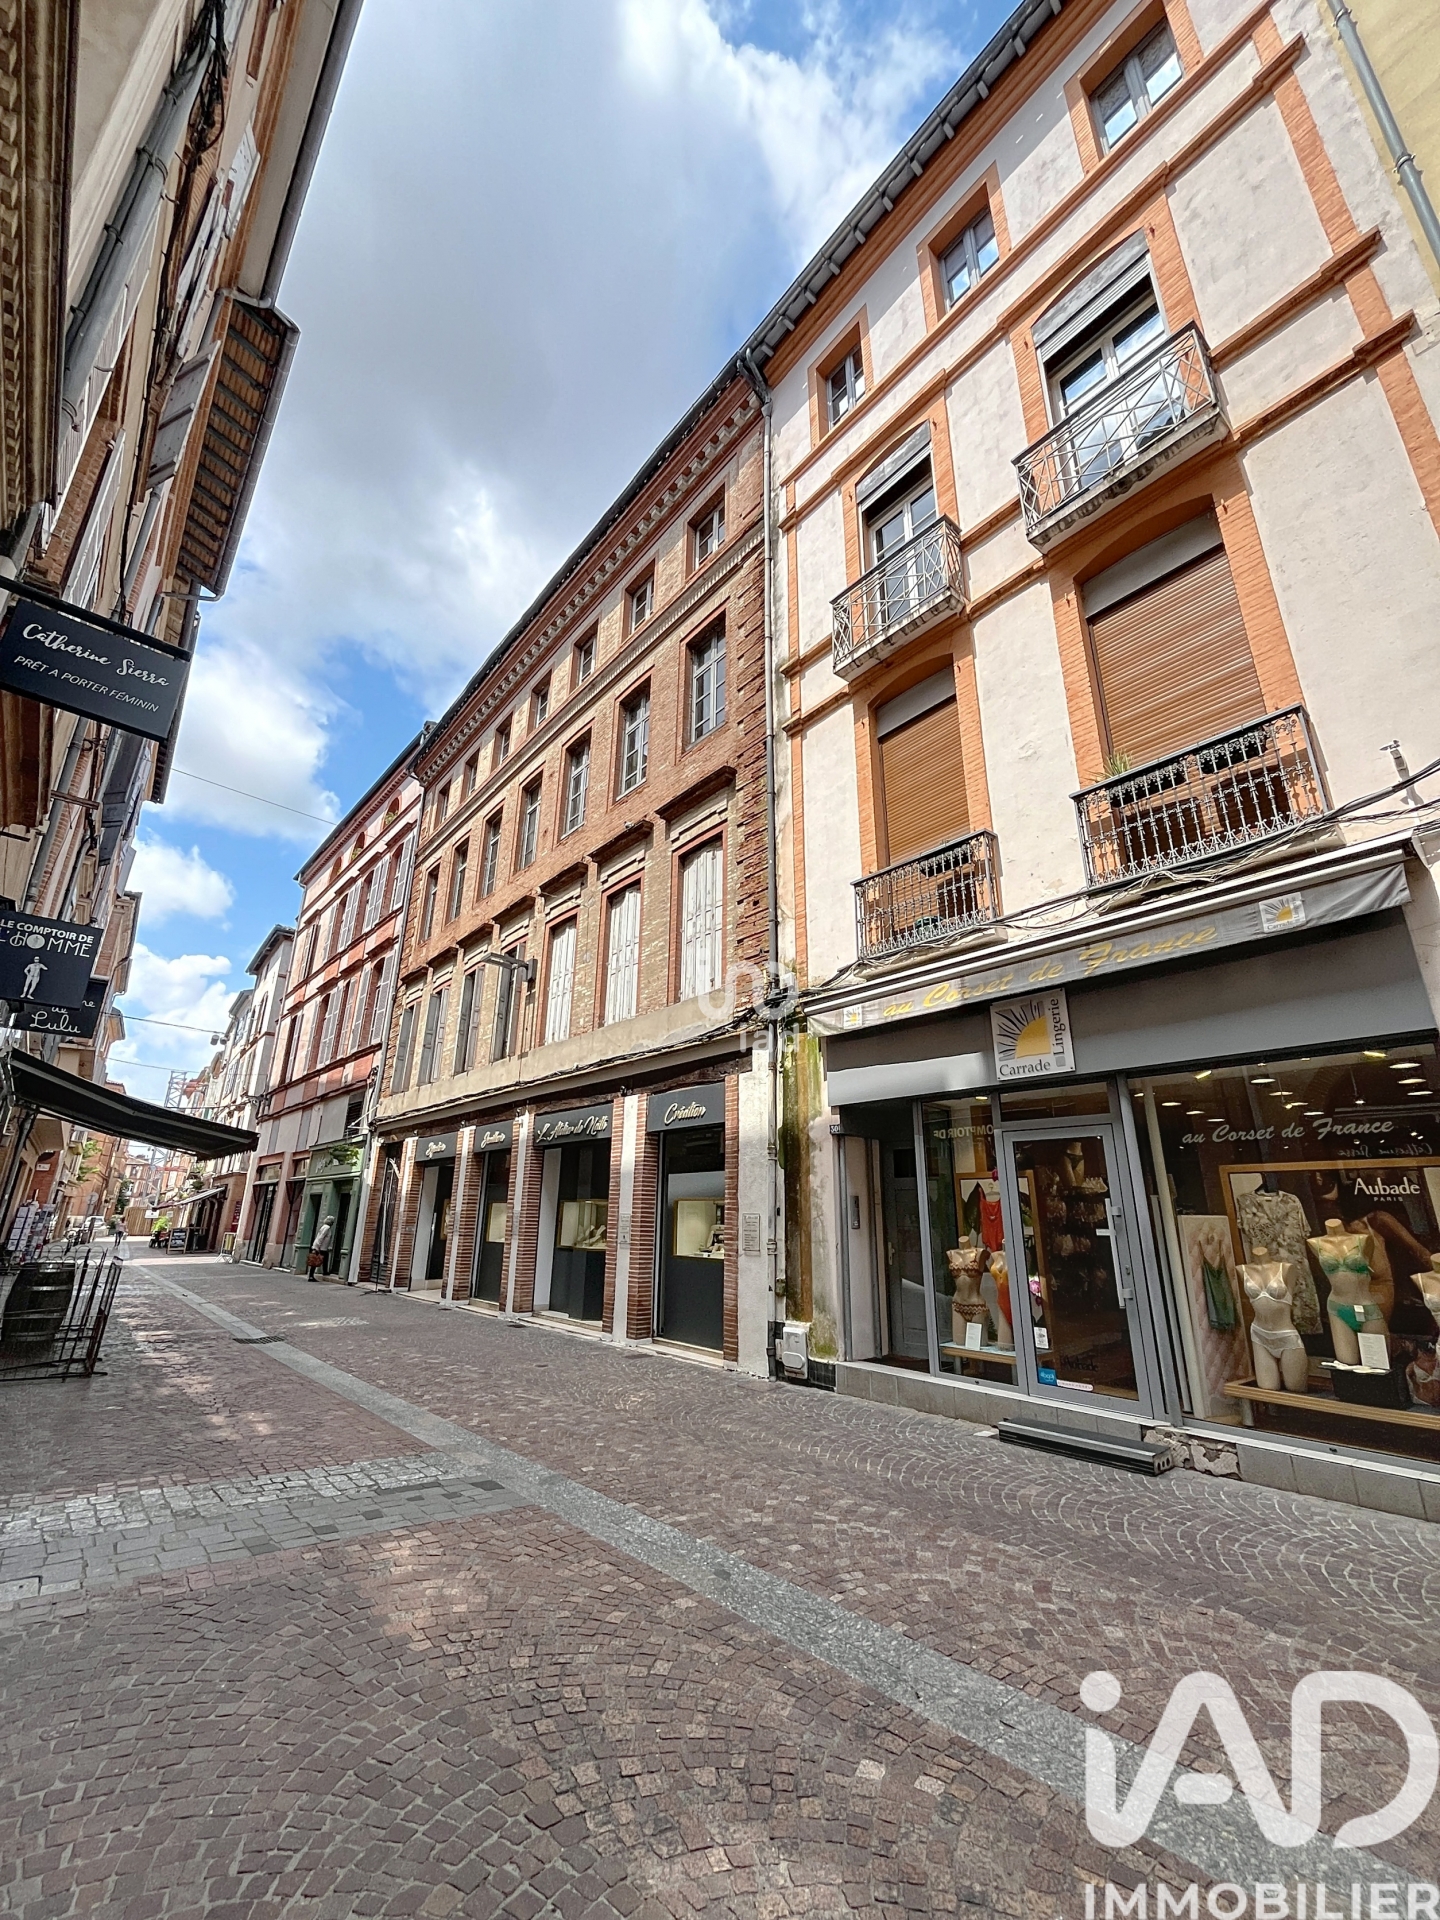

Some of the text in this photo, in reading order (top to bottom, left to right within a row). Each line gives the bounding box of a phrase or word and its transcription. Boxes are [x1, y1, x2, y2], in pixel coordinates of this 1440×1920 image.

[22, 623, 170, 687] Catherine Sierra
[13, 655, 160, 713] PRÊT A PORTER FÉMININ
[0, 919, 95, 944] LE COMPTOIR DE
[882, 1001, 915, 1018] au
[921, 972, 1014, 1007] Corset
[1028, 959, 1065, 984] de
[1078, 925, 1219, 976] France
[29, 1011, 82, 1034] Lulu
[1049, 998, 1065, 1056] Lingerie
[999, 1058, 1051, 1077] Carrade
[664, 1101, 707, 1125] Création
[1182, 1118, 1396, 1144] au Corset de France
[1354, 1177, 1421, 1196] Aubade
